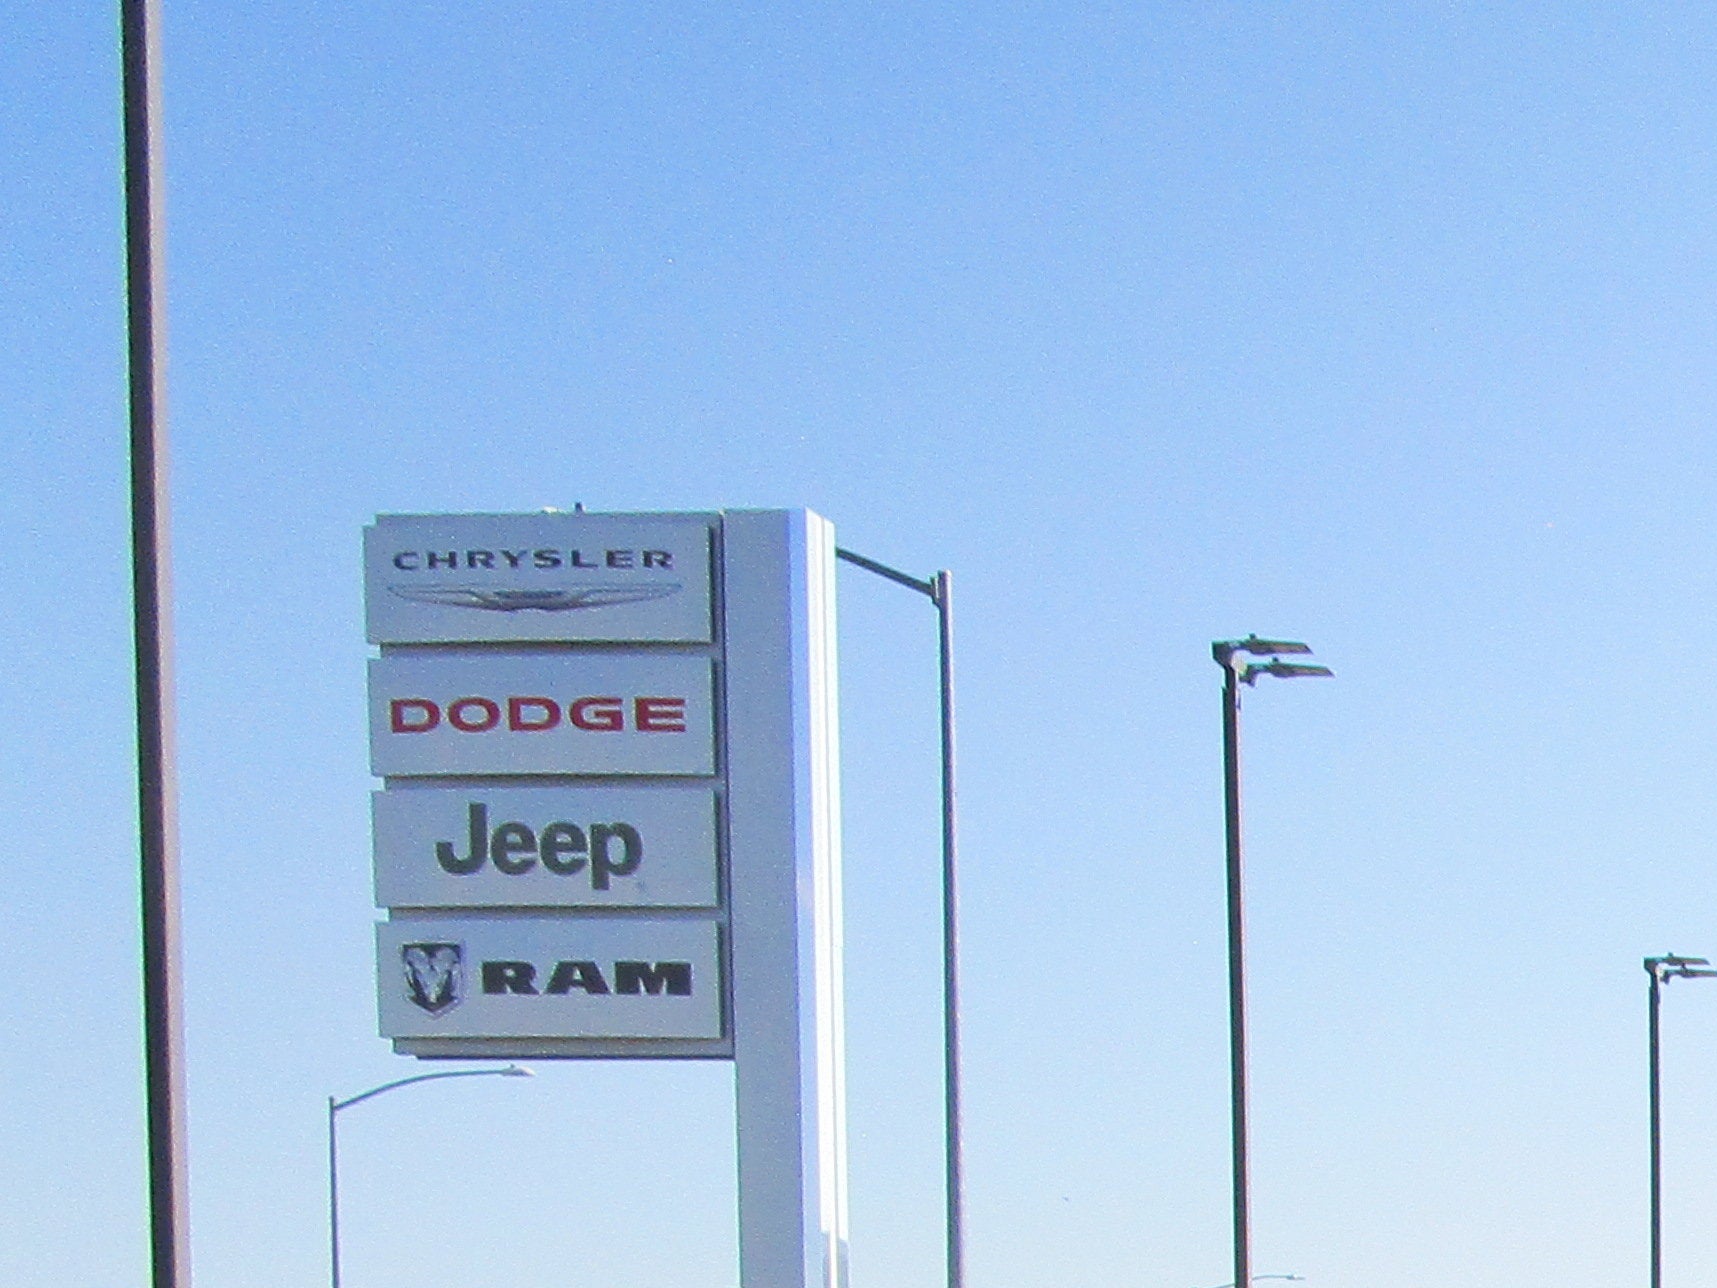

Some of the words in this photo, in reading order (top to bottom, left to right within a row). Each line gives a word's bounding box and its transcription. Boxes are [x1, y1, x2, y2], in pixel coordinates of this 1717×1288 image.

[392, 549, 674, 571] CHRYSLER
[389, 697, 687, 734] DODGE
[435, 802, 643, 891] Jeep
[481, 960, 693, 996] RAM
